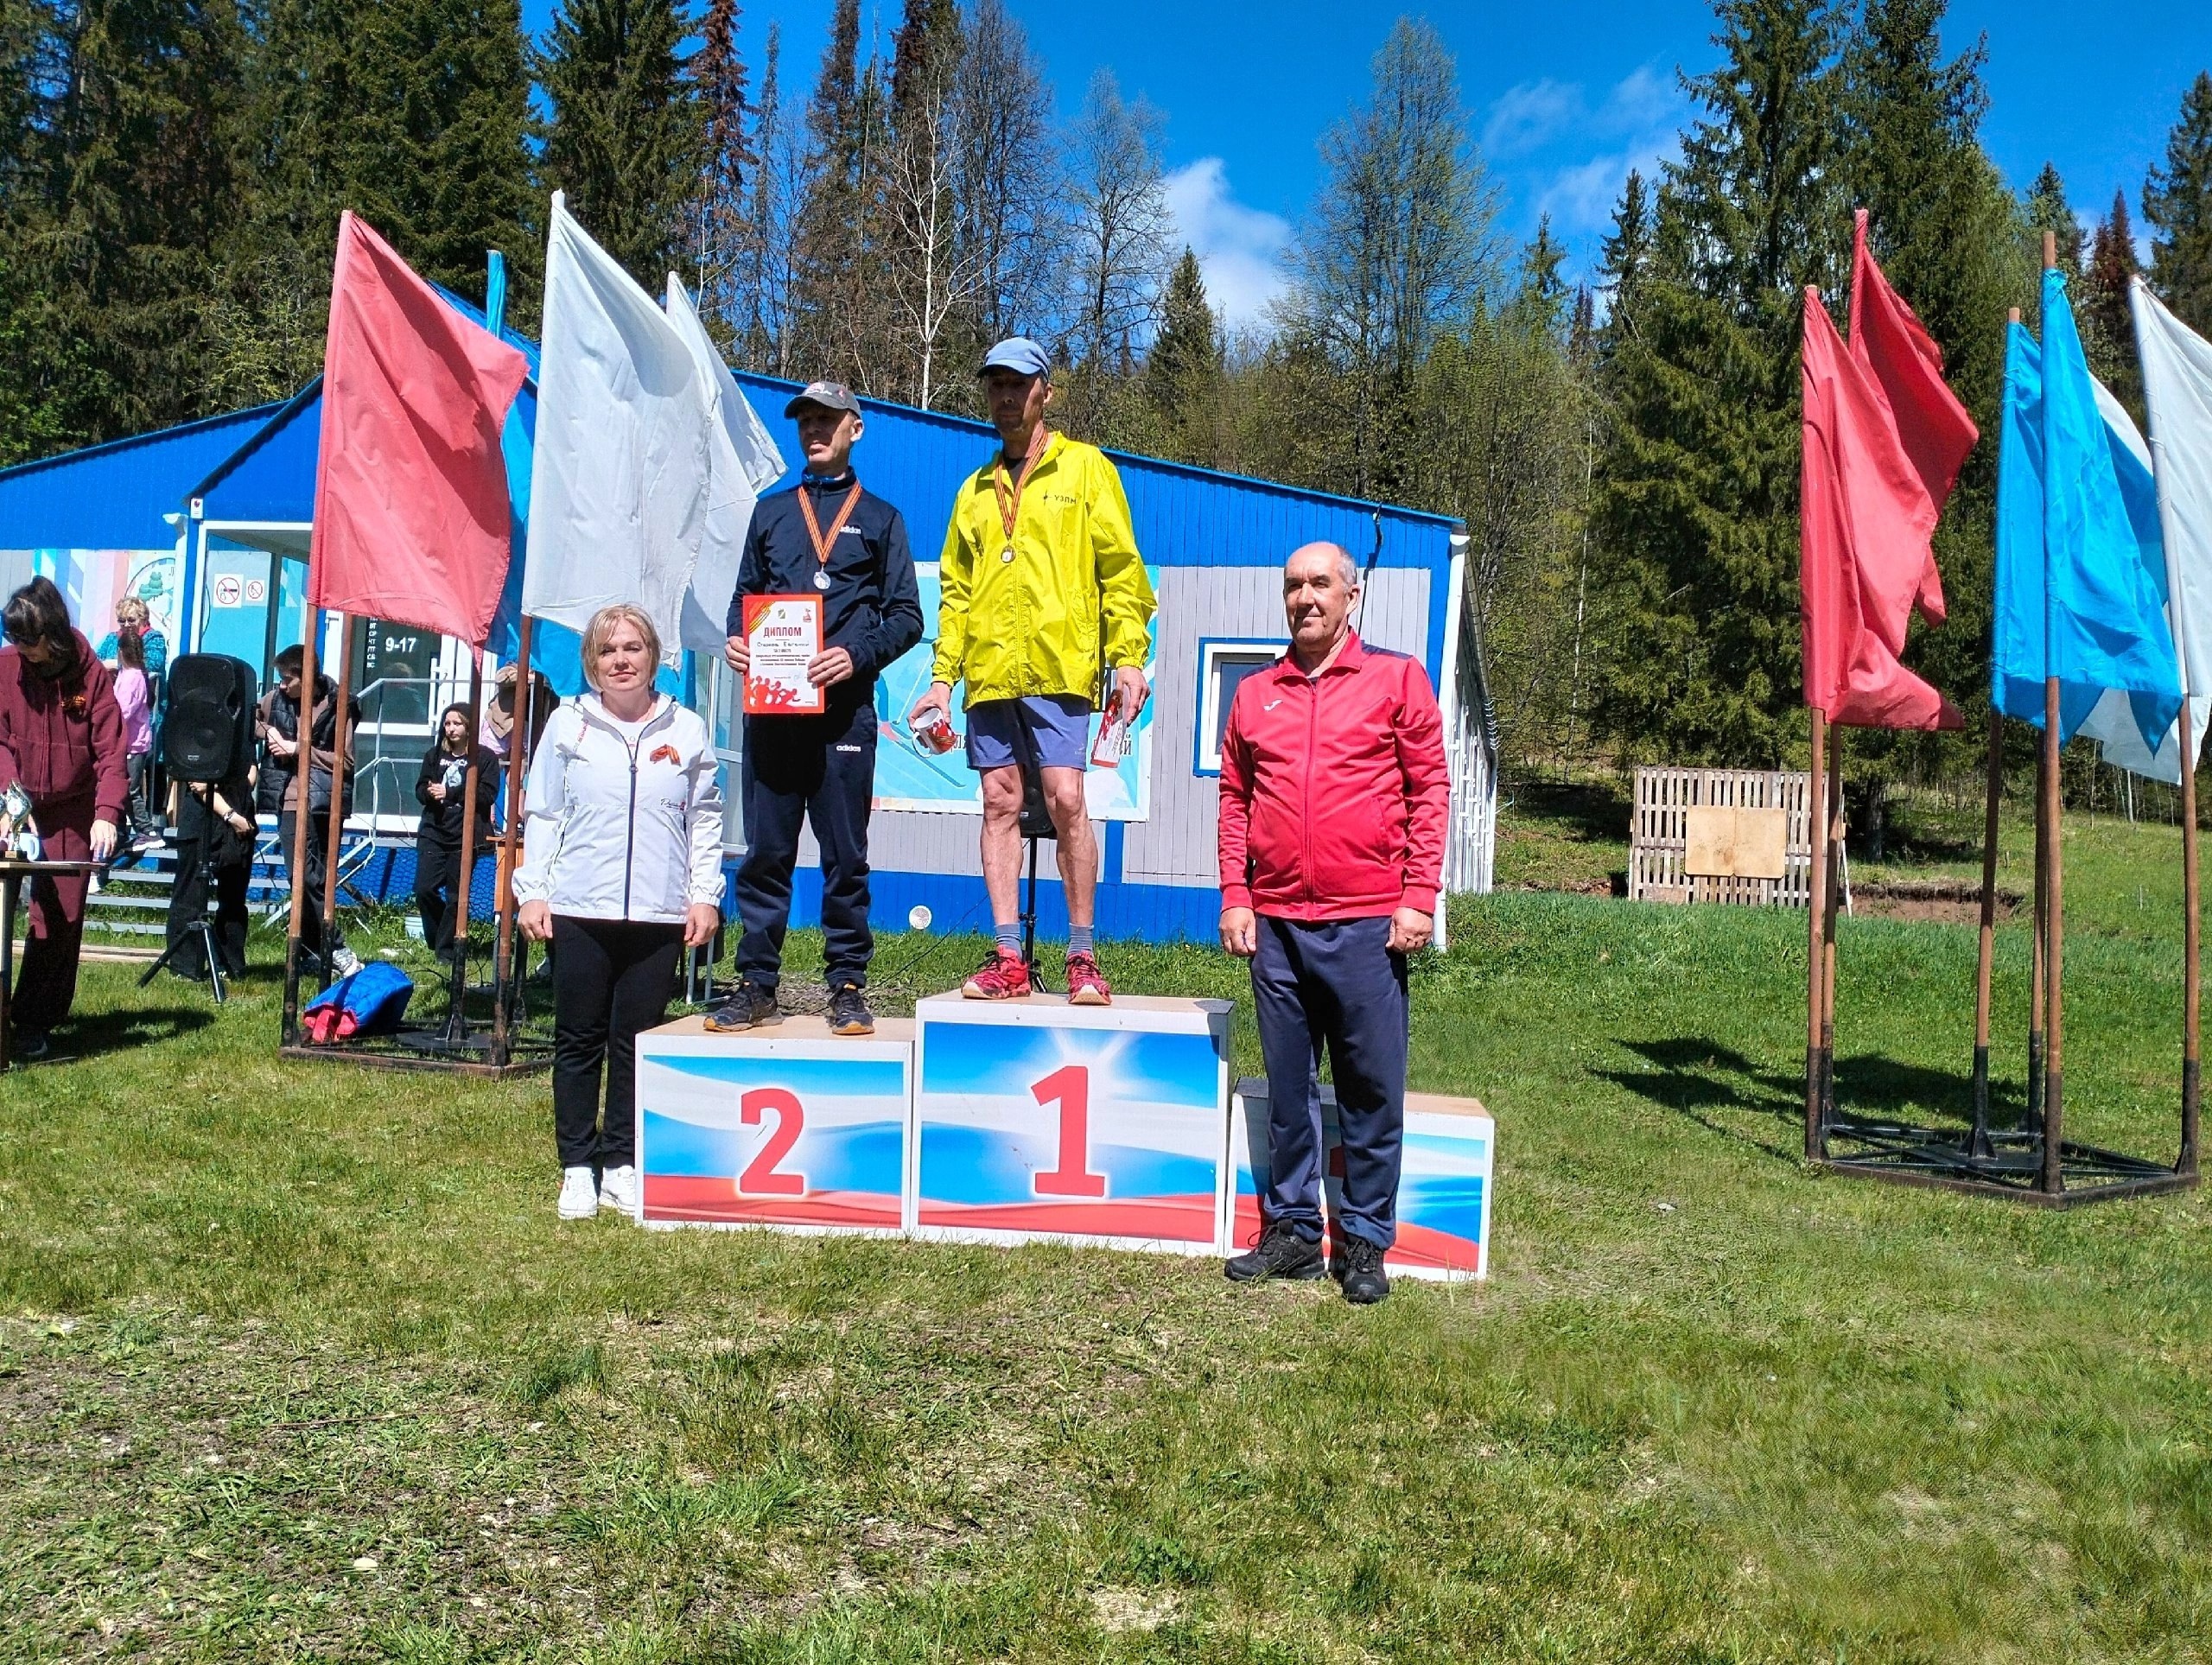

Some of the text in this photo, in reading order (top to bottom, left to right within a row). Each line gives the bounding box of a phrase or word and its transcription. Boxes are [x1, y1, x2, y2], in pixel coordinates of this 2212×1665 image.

[763, 626, 802, 638] ДИПЛОМ
[385, 636, 416, 653] 9-17
[836, 744, 861, 753] adidas
[1031, 1065, 1105, 1197] 1
[740, 1088, 804, 1195] 2
